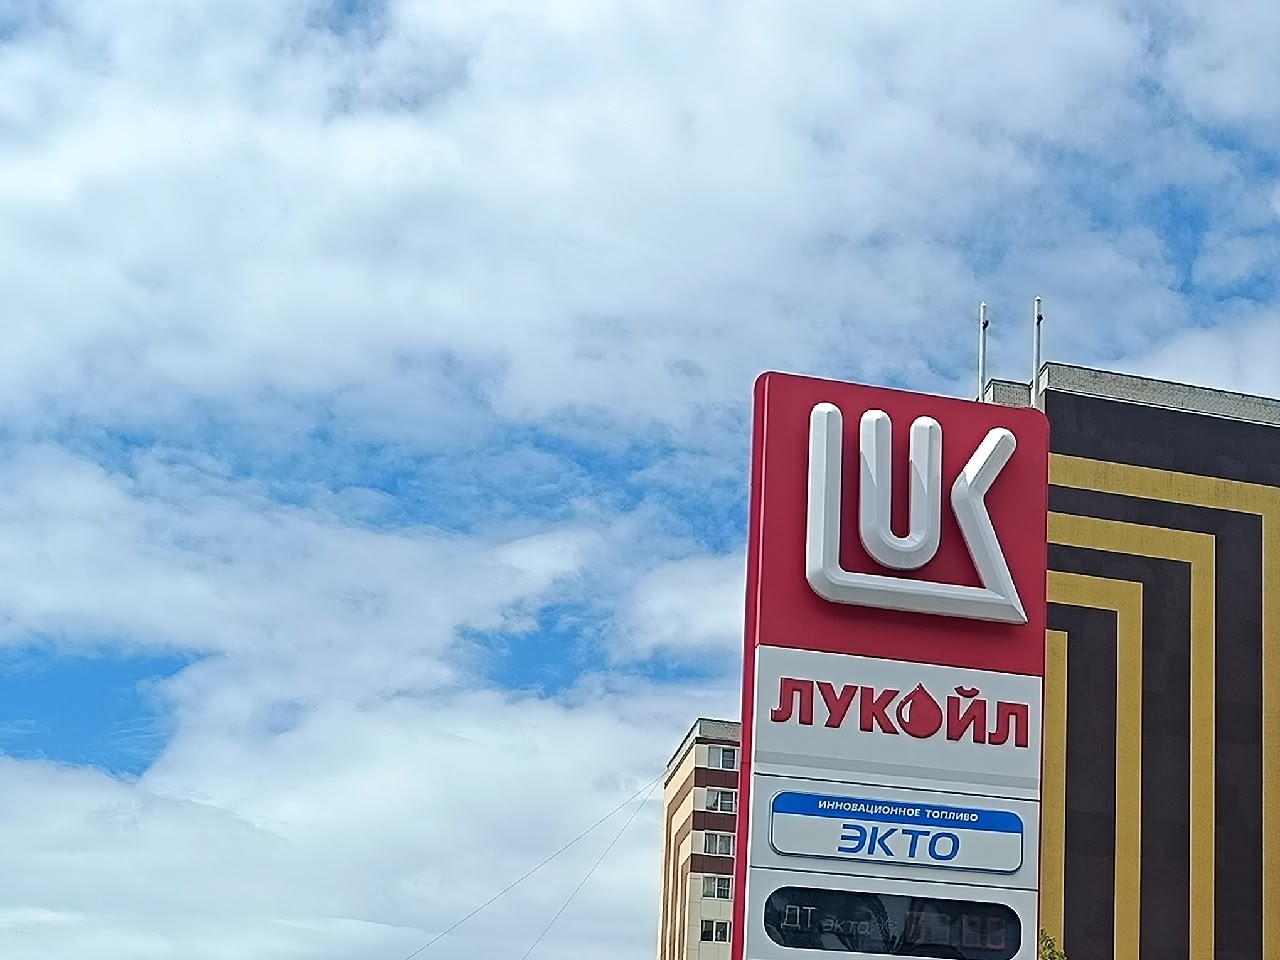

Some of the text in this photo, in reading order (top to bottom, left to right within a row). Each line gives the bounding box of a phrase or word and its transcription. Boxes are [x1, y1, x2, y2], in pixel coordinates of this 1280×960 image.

[818, 800, 979, 822] ИННОВАЦИОННОЕ ТОПЛИВО
[837, 823, 960, 861] ЭКТО
[781, 905, 870, 935] ДТ ЭКТО
